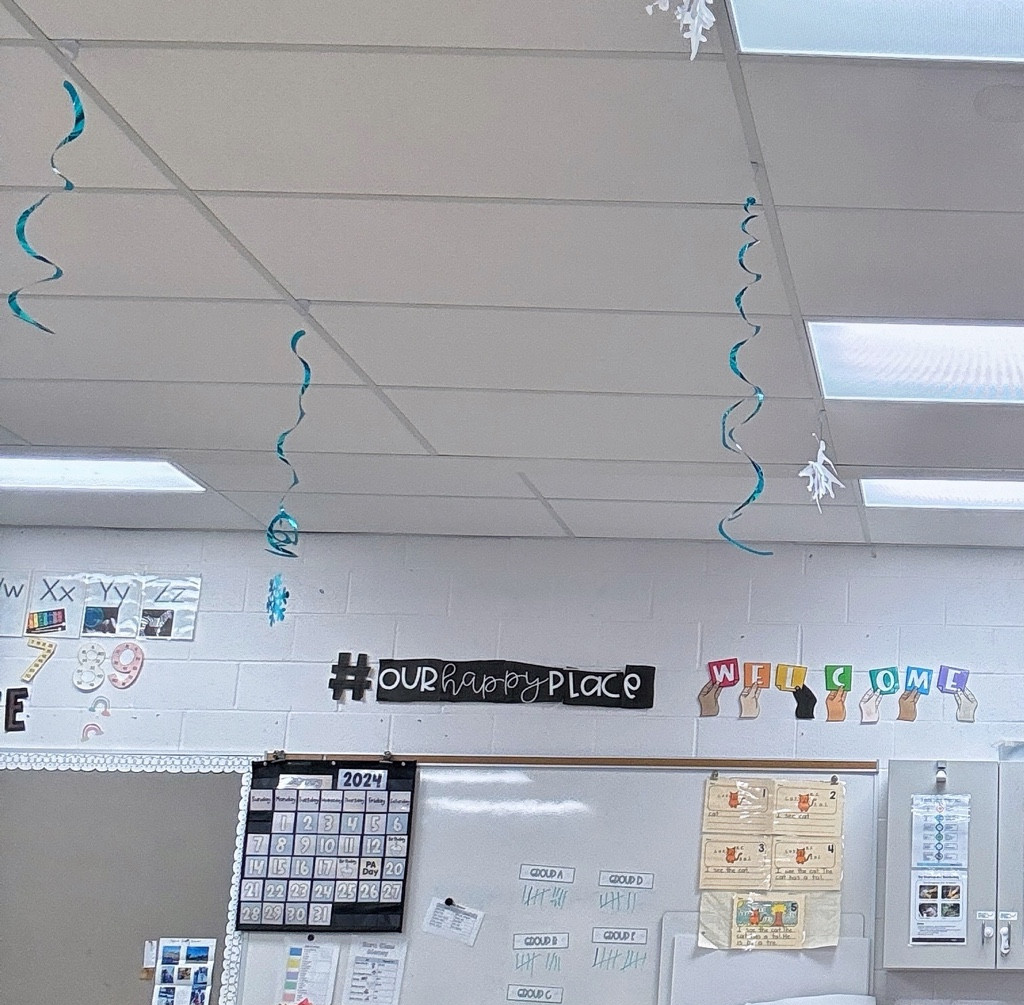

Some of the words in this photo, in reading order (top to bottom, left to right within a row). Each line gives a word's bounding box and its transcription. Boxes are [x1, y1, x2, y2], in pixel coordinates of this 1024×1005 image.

[0, 577, 24, 598] w
[40, 578, 76, 602] Xx
[100, 580, 130, 608] Yy
[21, 637, 57, 683] 7
[72, 642, 106, 693] 8
[108, 642, 145, 689] 9
[441, 663, 549, 703] happy
[713, 664, 961, 693] WELCOME
[343, 772, 383, 788] 2024
[276, 796, 296, 804] Monday
[829, 790, 837, 800] 2
[281, 815, 287, 831] 1
[303, 815, 313, 830] 2
[324, 815, 334, 831] 3
[347, 817, 358, 831] 4
[371, 816, 380, 832] 5
[393, 817, 402, 832] 6
[253, 836, 263, 852] 7
[275, 837, 287, 852] 8
[300, 836, 310, 854] 9
[320, 838, 336, 854] 10
[344, 837, 354, 853] 11
[366, 838, 381, 854] 12
[758, 843, 765, 853] 3
[827, 844, 834, 854] 4
[249, 859, 265, 875] 14
[273, 858, 287, 875] 15
[295, 860, 309, 876] 16
[318, 860, 333, 875] 17
[362, 868, 379, 877] Day
[366, 860, 376, 868] PA
[385, 862, 403, 876] 20
[244, 882, 260, 897] 21
[266, 884, 284, 898] 22
[291, 883, 308, 897] 23
[314, 884, 333, 899] 24
[338, 883, 357, 899] 25
[360, 884, 379, 899] 26
[383, 884, 401, 900] 27
[242, 907, 260, 921] 28
[265, 905, 281, 921] 29
[287, 907, 305, 921] 30
[312, 905, 328, 922] 31
[790, 902, 798, 912] 5
